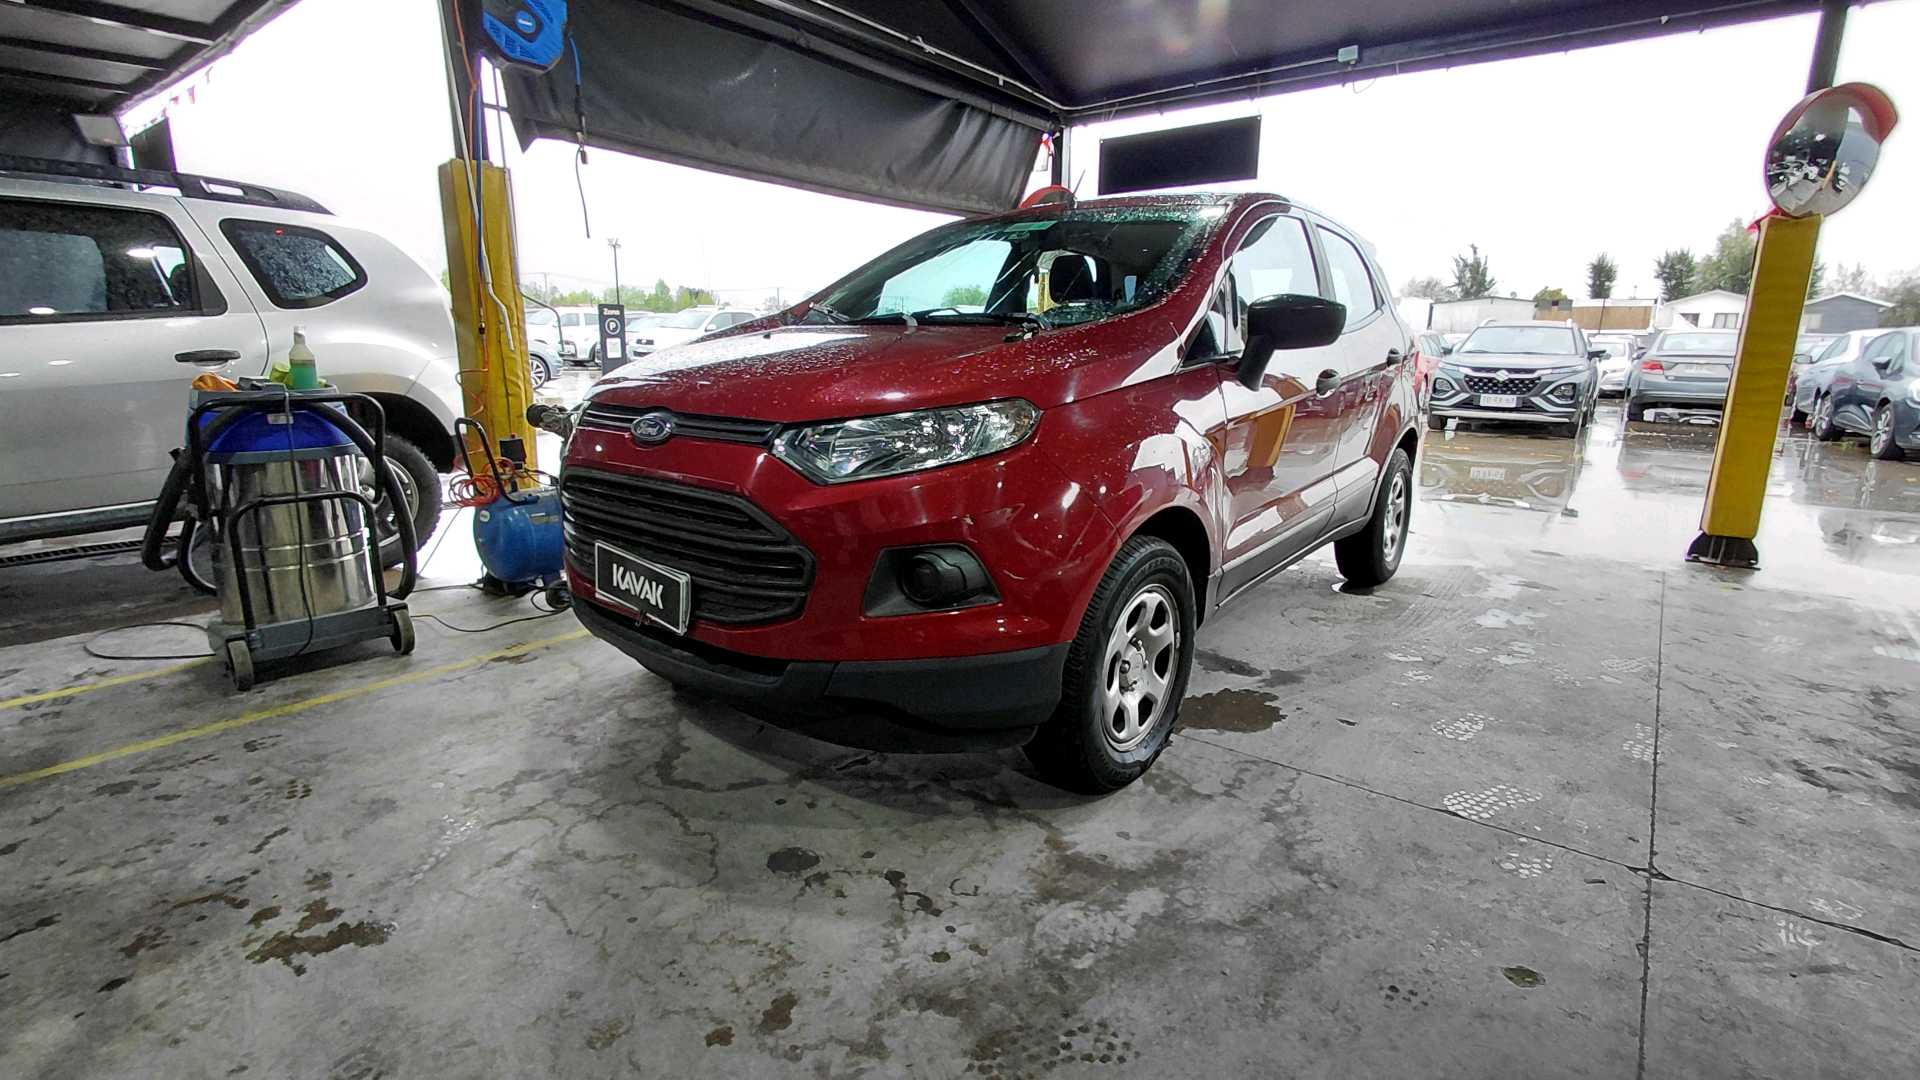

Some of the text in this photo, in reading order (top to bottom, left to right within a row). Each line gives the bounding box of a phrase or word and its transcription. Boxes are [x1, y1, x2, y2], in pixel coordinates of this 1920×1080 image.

[609, 321, 617, 331] P
[636, 420, 660, 436] Ford
[612, 563, 664, 609] KAVAK
